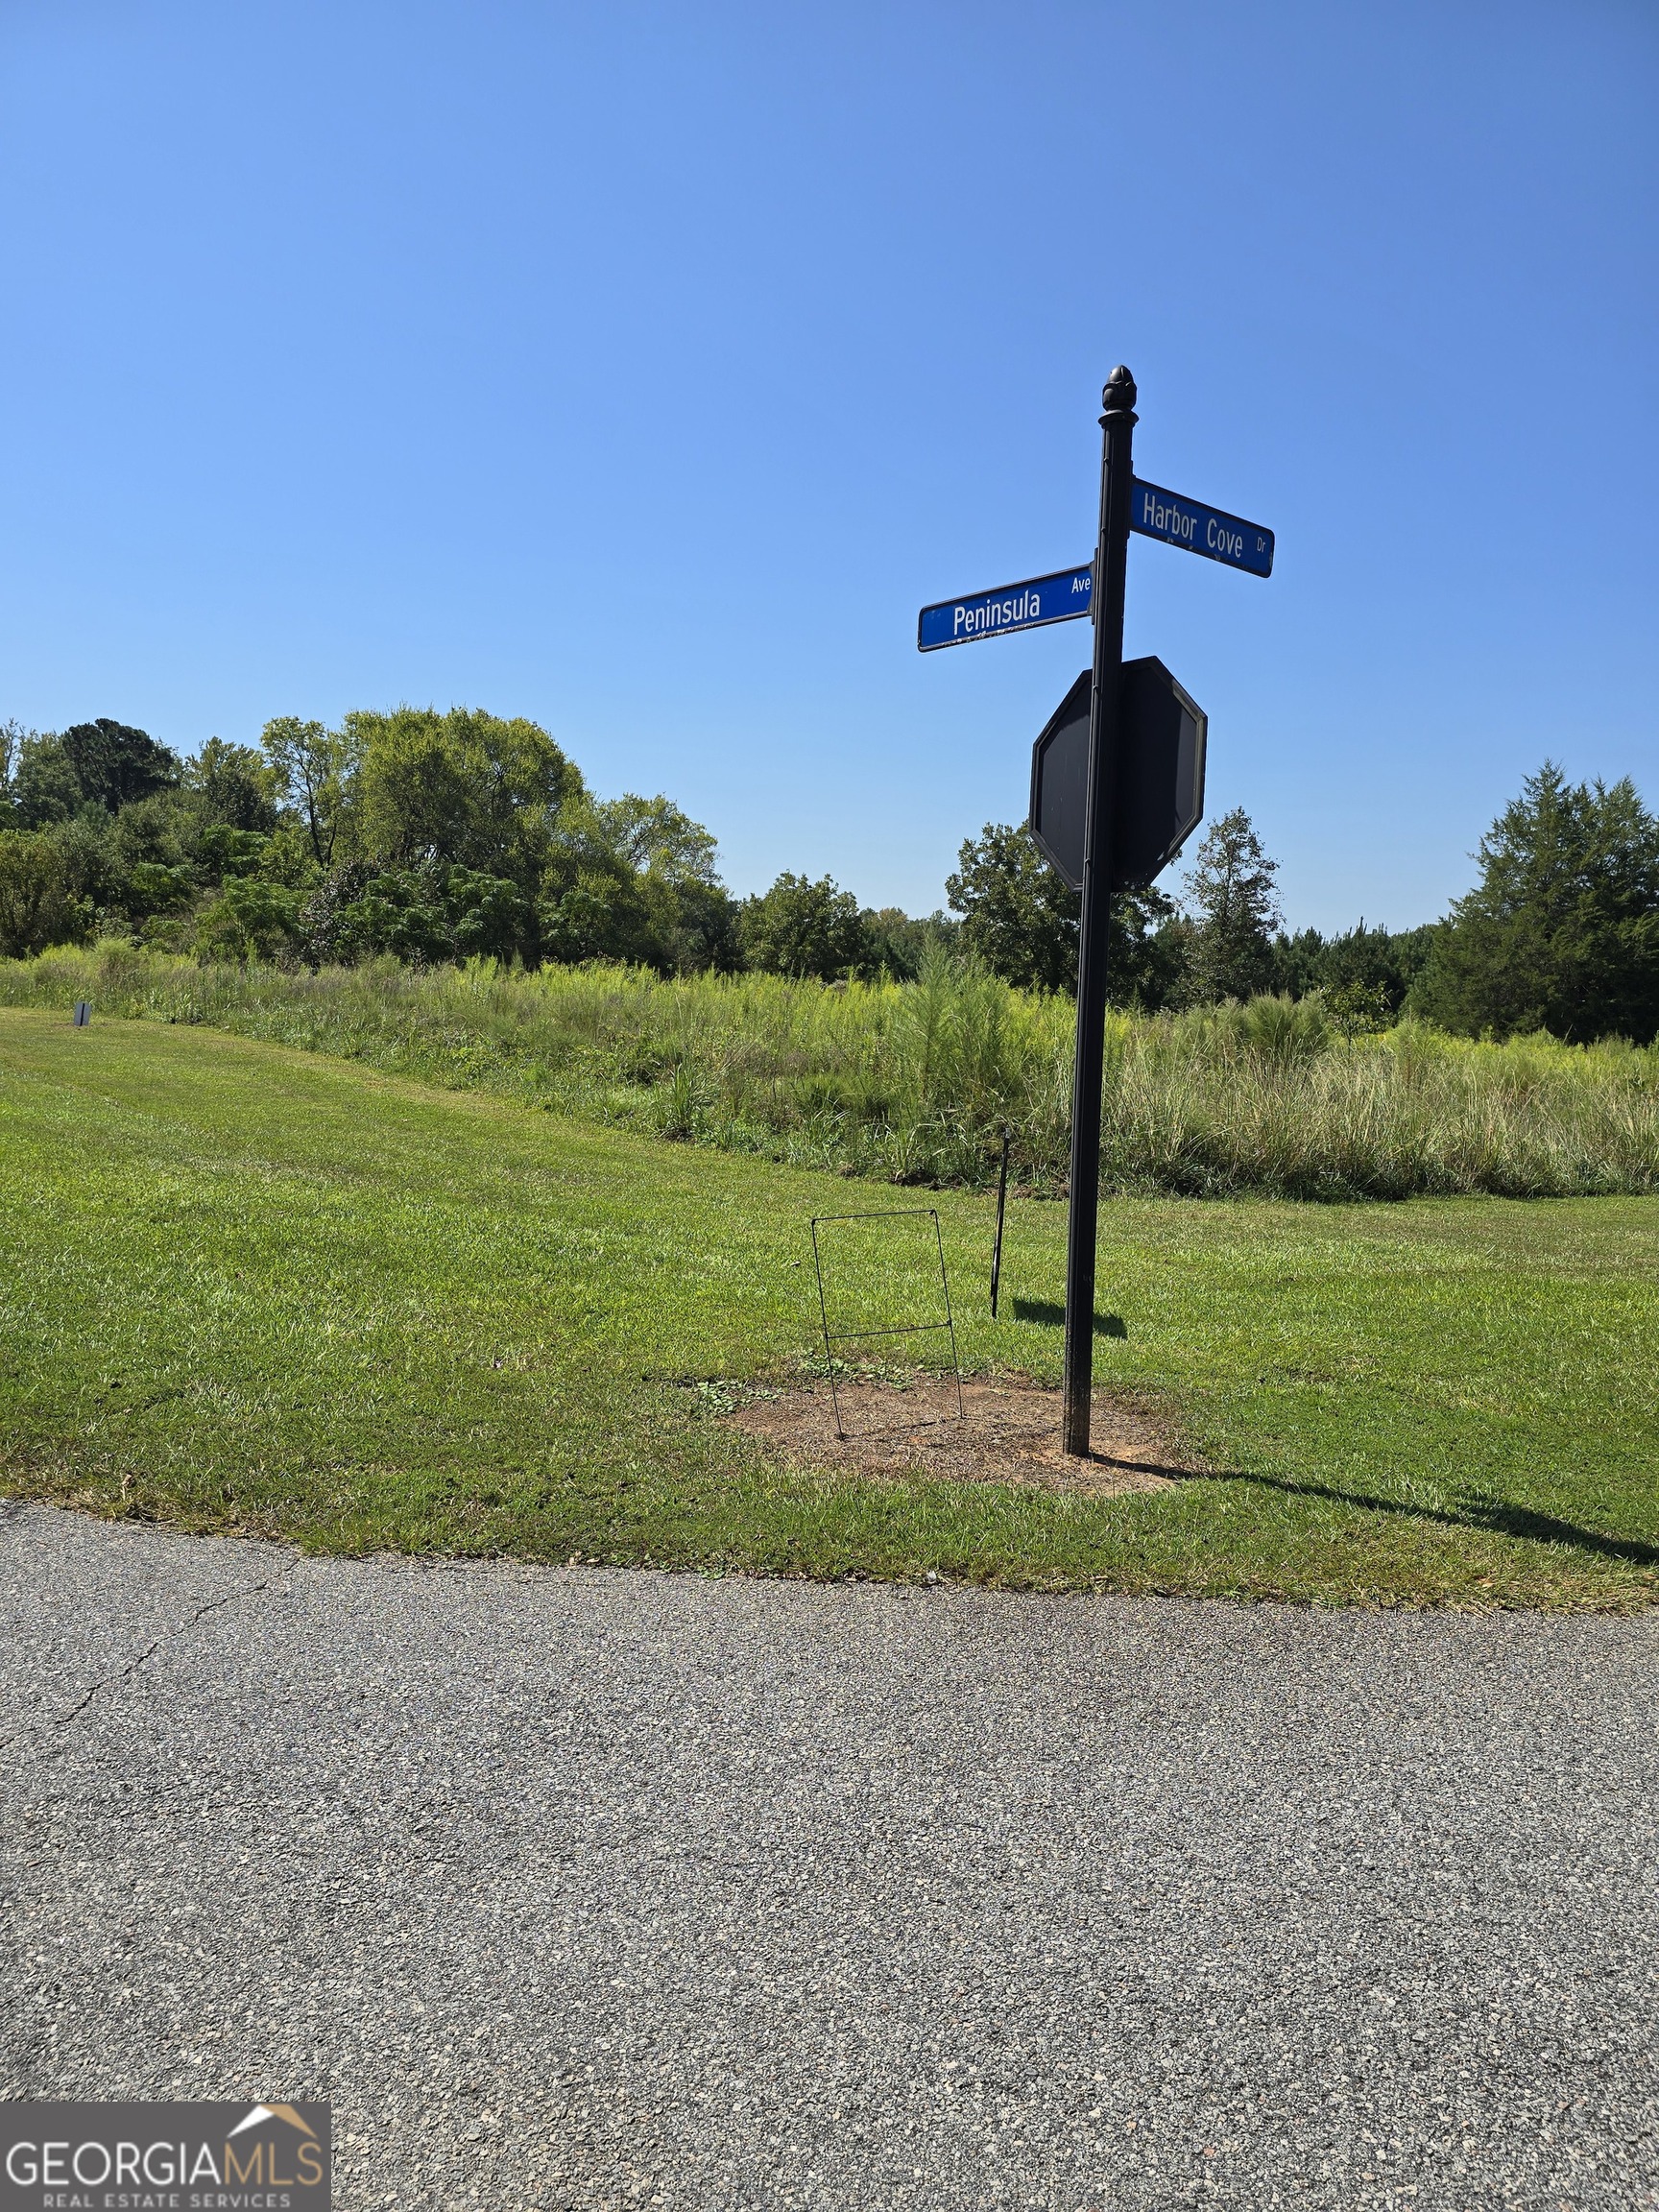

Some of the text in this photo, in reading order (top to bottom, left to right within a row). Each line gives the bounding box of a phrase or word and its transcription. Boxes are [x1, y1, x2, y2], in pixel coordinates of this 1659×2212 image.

[1142, 492, 1266, 559] Harbor Cove Dr
[953, 577, 1091, 636] Peninsula Ave
